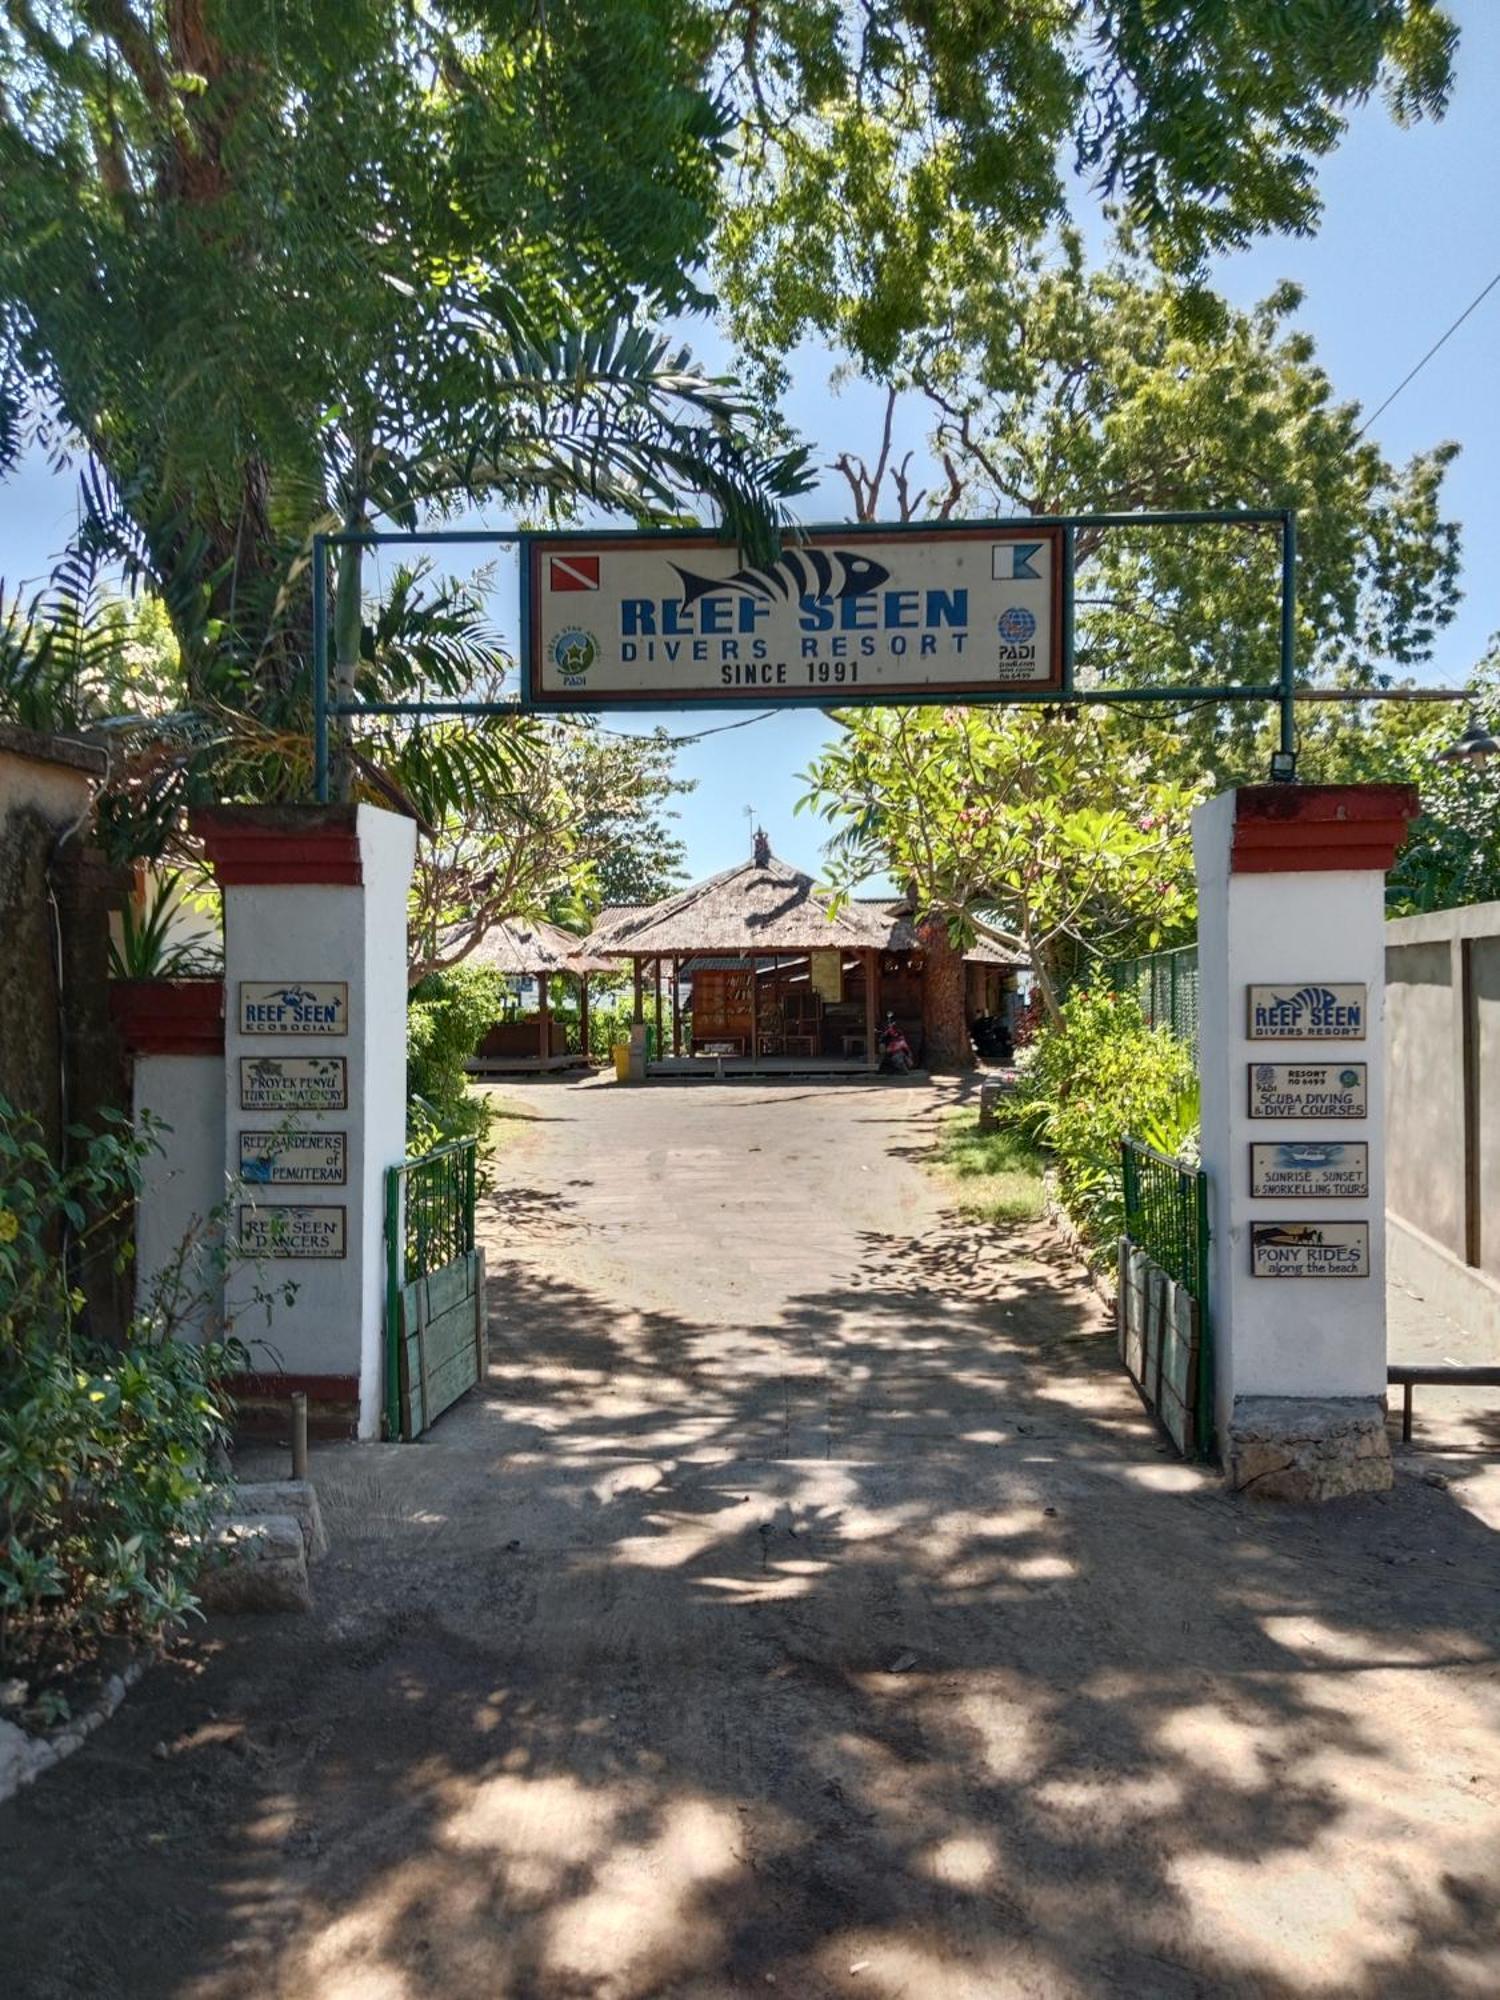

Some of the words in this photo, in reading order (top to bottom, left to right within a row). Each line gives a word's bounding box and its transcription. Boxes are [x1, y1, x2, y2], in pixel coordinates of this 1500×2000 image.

[620, 597, 771, 636] REEF
[798, 588, 969, 632] SEEN
[621, 638, 768, 662] DIVERS
[801, 633, 969, 659] RESORT
[999, 645, 1036, 660] PADI
[721, 662, 787, 684] SINCE
[807, 661, 859, 683] 1991
[563, 676, 586, 686] PADI
[246, 1004, 287, 1022] REEF
[293, 1005, 336, 1023] SEEN
[1255, 1007, 1303, 1027] REEF
[1311, 1006, 1361, 1027] SEEN
[246, 1023, 336, 1032] ECOSOCIAL
[1255, 1027, 1304, 1036] DIVERS
[1307, 1027, 1361, 1036] RESORT
[1288, 1070, 1328, 1078] RESORT
[250, 1077, 298, 1089] PROYEK
[1256, 1083, 1277, 1093] PADI
[1260, 1093, 1303, 1105] SCUBA
[1306, 1093, 1353, 1105] DIVING
[1264, 1104, 1296, 1116] DIVE
[1300, 1104, 1364, 1116] COURSES
[243, 1136, 271, 1149] REEF
[326, 1153, 340, 1166] of
[272, 1167, 342, 1180] PEMUTERAN
[1265, 1171, 1313, 1182] SUNRISE
[1321, 1171, 1364, 1182] SUNSET
[1262, 1183, 1331, 1194] SNORKELLING
[1331, 1183, 1368, 1194] TOURS
[249, 1221, 290, 1234] REF
[292, 1221, 337, 1234] SEEN
[256, 1235, 330, 1248] DANCERS
[1257, 1248, 1302, 1262] PONY
[1307, 1248, 1361, 1262] RIDES
[1268, 1262, 1304, 1276] along
[1307, 1261, 1326, 1273] the
[1328, 1262, 1358, 1273] beach
